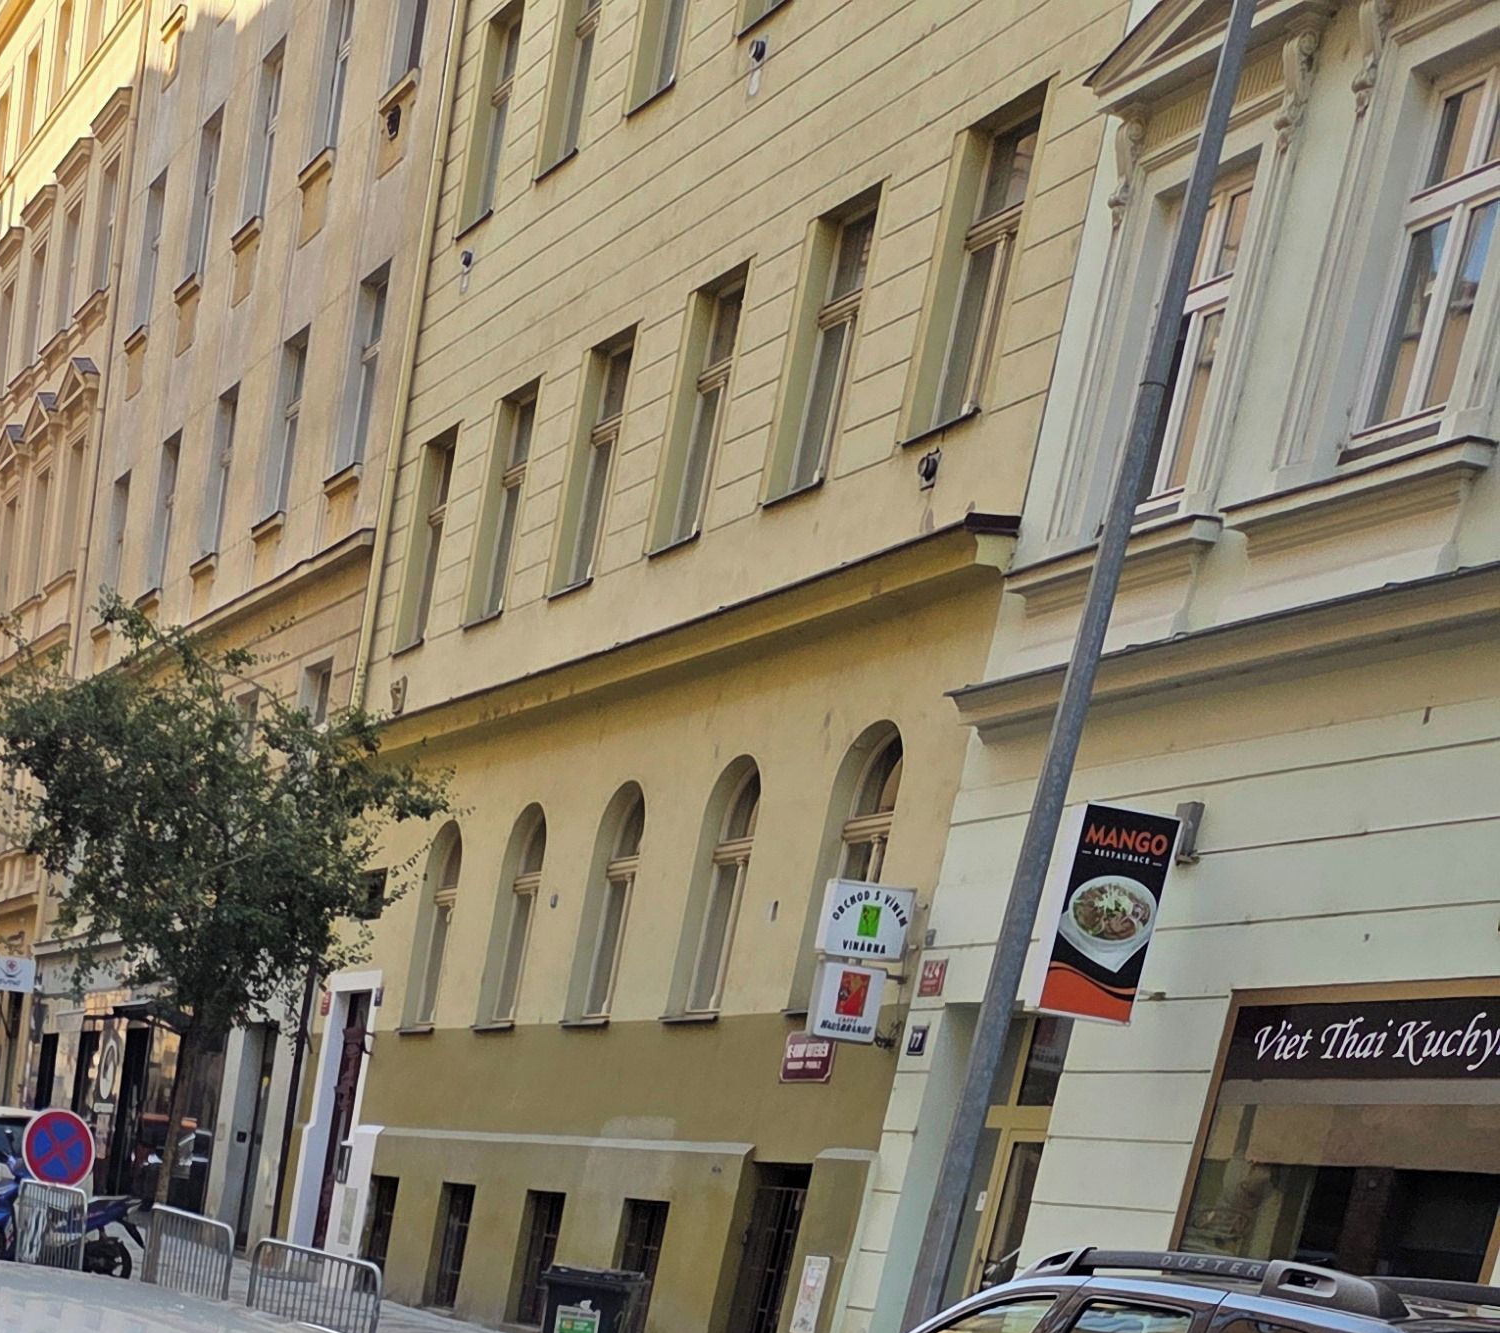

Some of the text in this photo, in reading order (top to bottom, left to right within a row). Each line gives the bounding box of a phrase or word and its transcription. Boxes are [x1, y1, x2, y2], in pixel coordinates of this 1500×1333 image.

[1085, 823, 1168, 856] MANGO
[1094, 848, 1151, 865] RESTAURACE
[832, 890, 870, 921] OBCHOD
[874, 890, 881, 901] S
[1254, 1012, 1500, 1072] Viet Thai Kuchy
[1160, 1255, 1262, 1278] DUSTER
